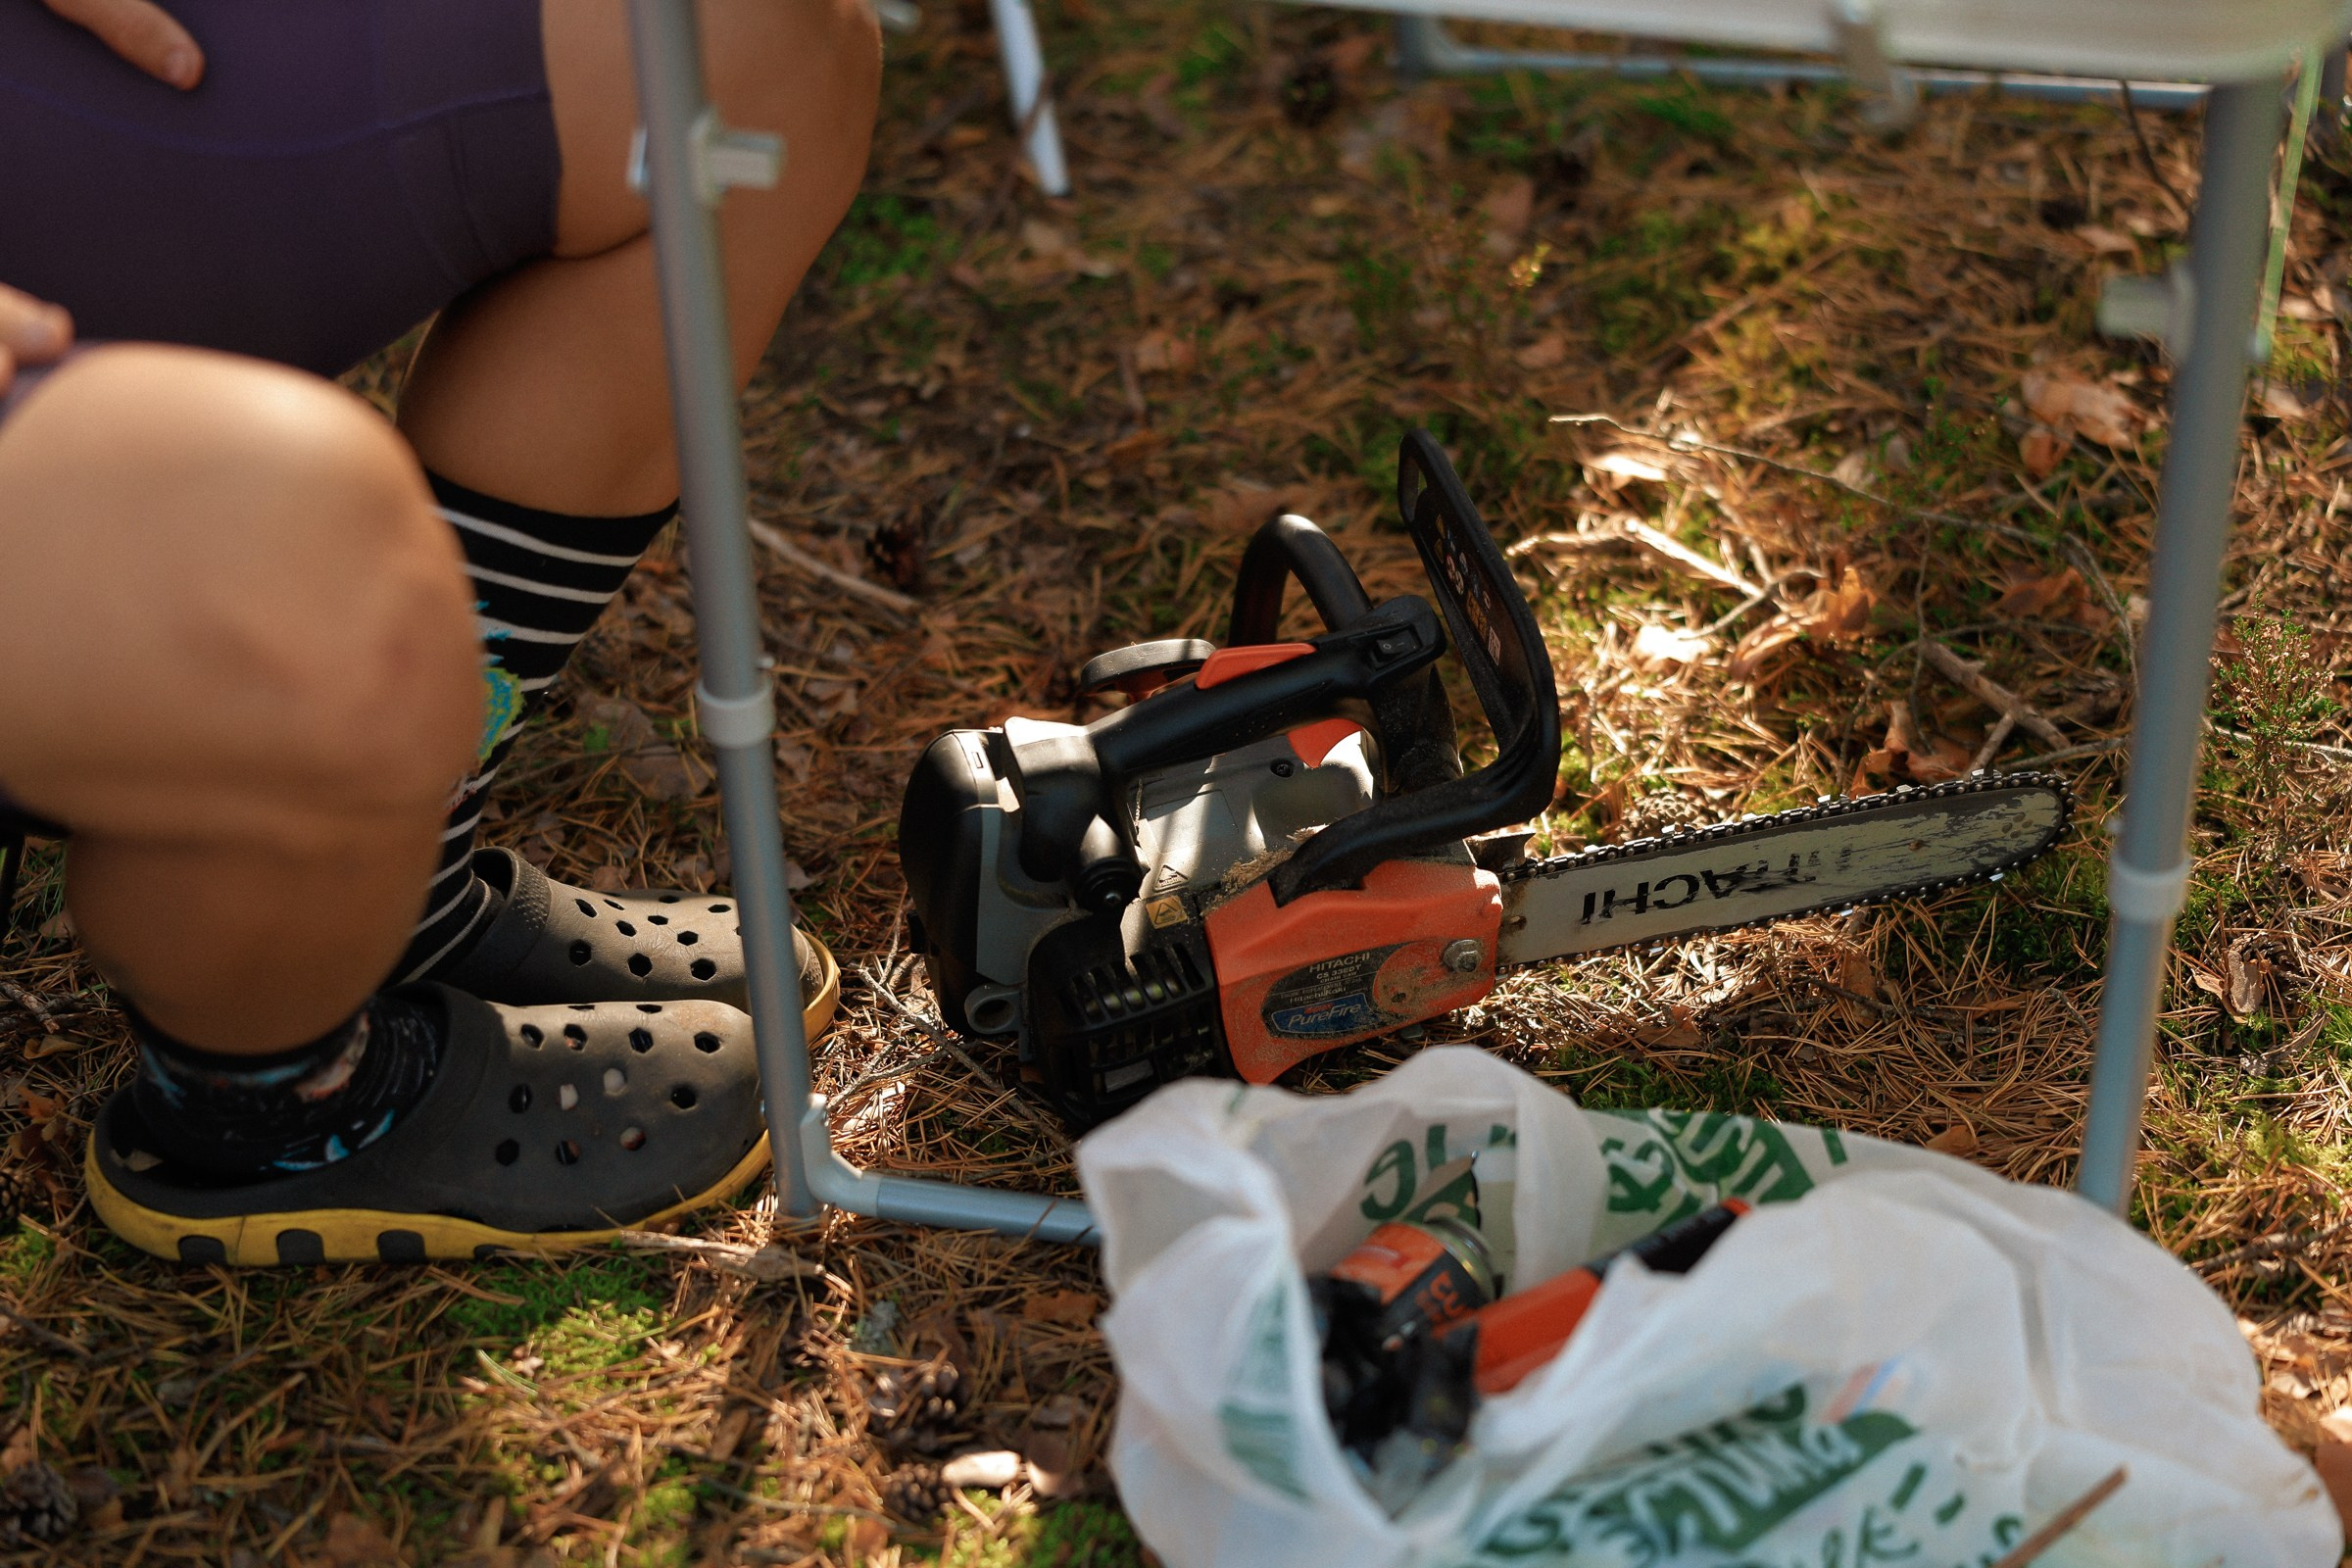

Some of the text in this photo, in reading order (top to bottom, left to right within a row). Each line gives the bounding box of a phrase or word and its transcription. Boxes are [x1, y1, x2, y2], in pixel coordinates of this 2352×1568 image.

[1309, 953, 1370, 973] HITACHI
[1320, 975, 1342, 984] CHAIN
[1290, 991, 1324, 1004] Hitachi
[1288, 1004, 1361, 1027] PureFire
